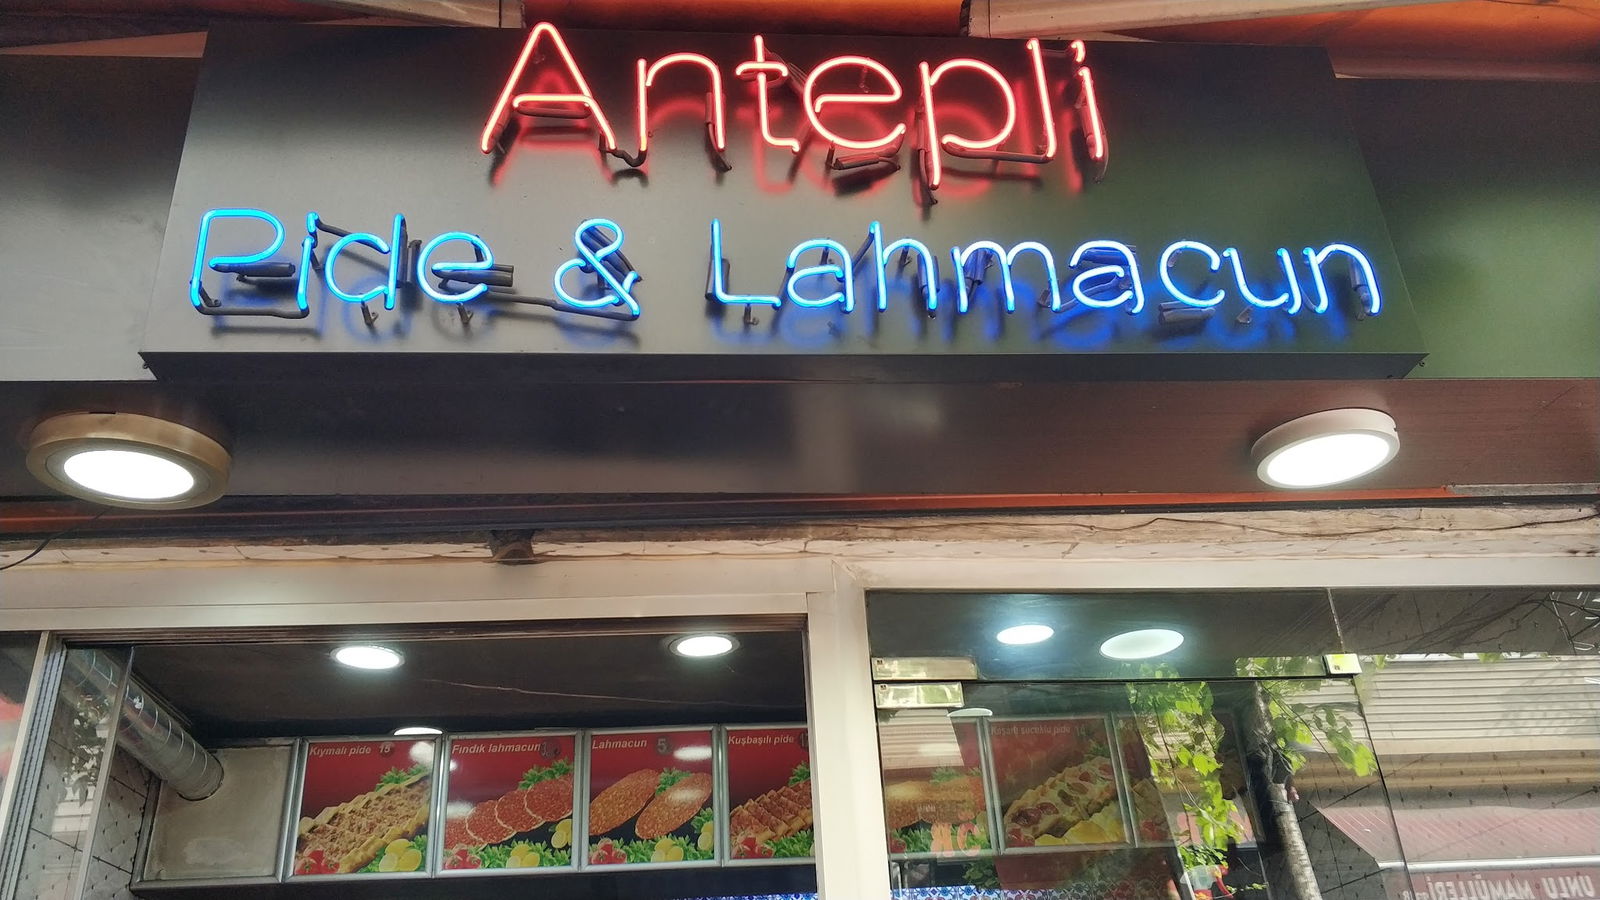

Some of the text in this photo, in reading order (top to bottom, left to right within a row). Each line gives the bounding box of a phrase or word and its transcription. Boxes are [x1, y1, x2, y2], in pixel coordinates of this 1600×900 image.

[479, 21, 1107, 189] Antepli
[189, 207, 1383, 317] Pide & Lahmacun
[452, 744, 485, 755] Fındık
[488, 743, 541, 754] lahmacun
[592, 738, 667, 753] Lahmacun 5
[728, 735, 773, 751] Kuşbaşılı
[775, 735, 794, 749] pide
[309, 746, 347, 757] Kıymalı
[348, 745, 372, 757] pide
